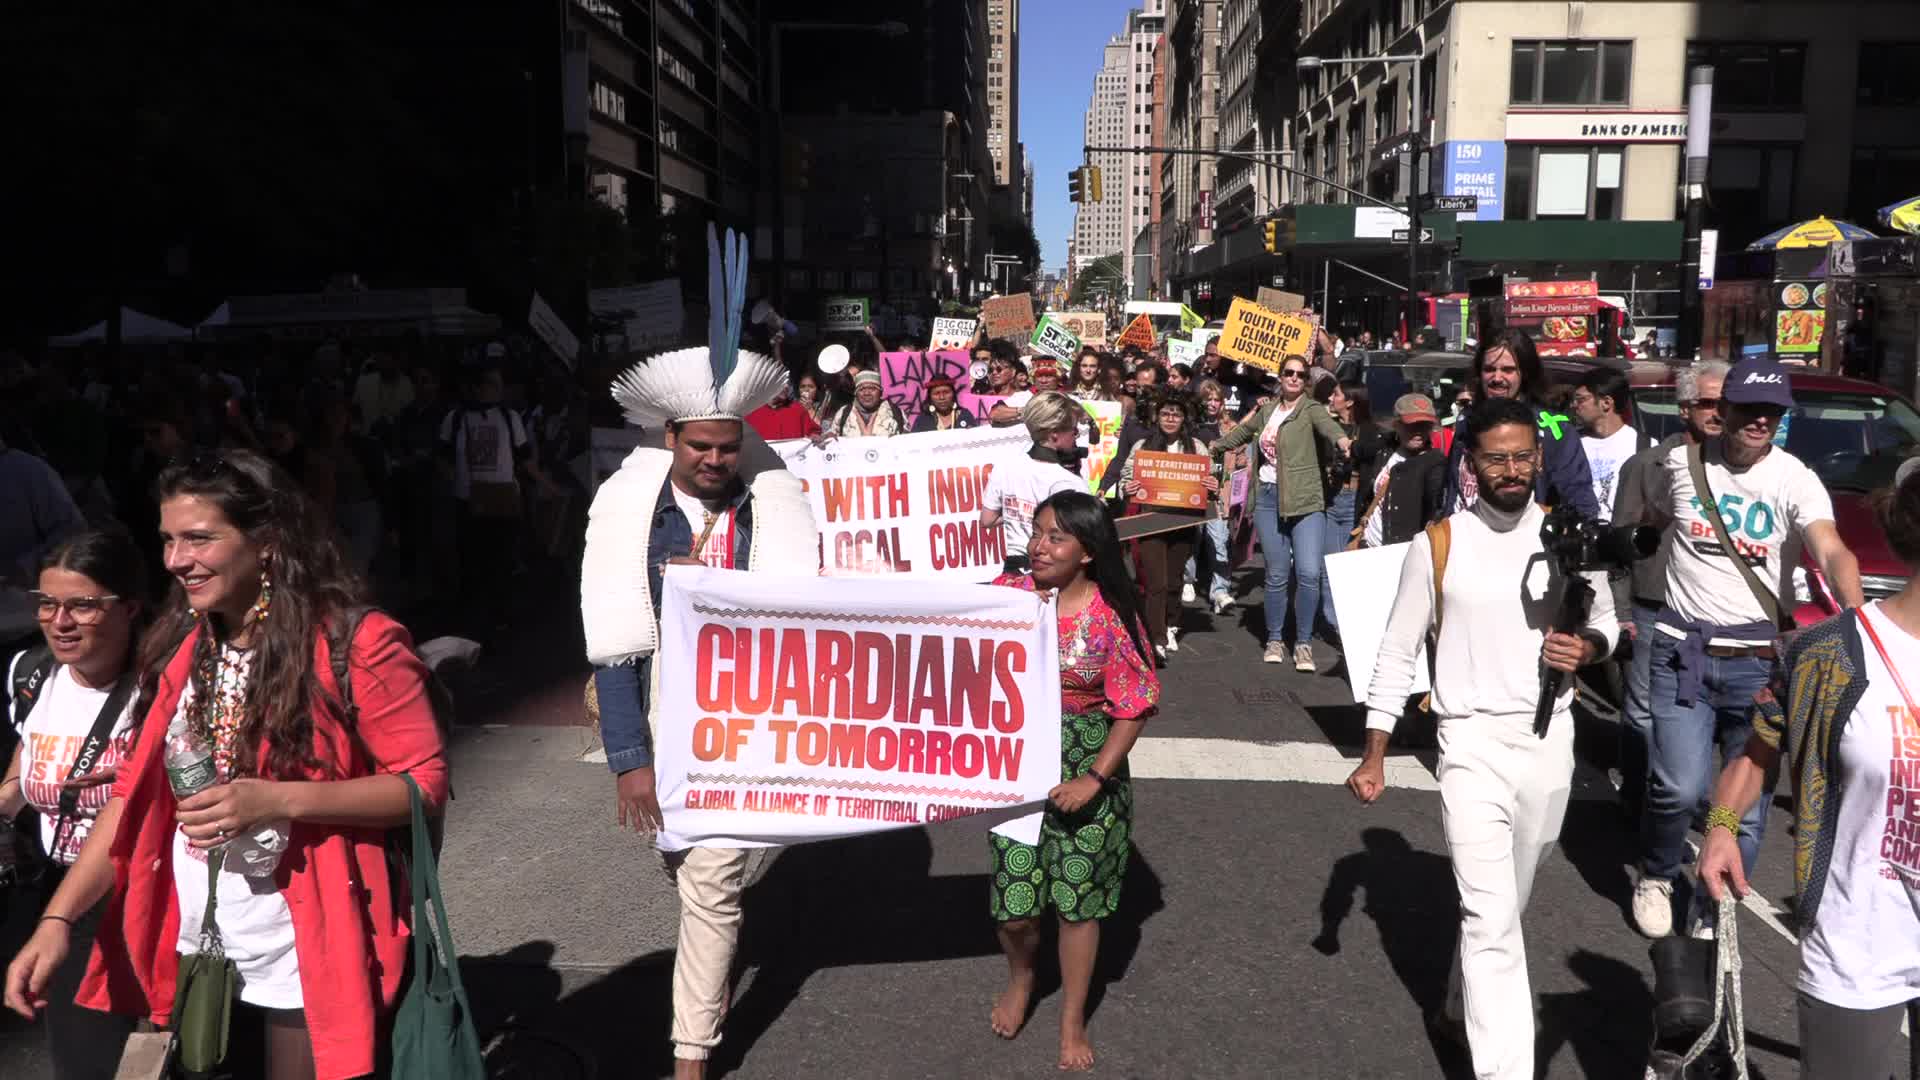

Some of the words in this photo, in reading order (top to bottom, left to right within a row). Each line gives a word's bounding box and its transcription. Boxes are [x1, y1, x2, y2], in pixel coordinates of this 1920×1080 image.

[1582, 124, 1617, 136] BANK
[1621, 124, 1637, 136] OF
[1456, 143, 1482, 159] 150
[1454, 172, 1496, 185] PRIME
[1454, 186, 1497, 198] RETAIL
[1440, 199, 1468, 210] Liberty
[936, 318, 955, 329] BIG
[957, 320, 974, 331] OIL
[1238, 309, 1276, 333] YOUTH
[1277, 322, 1302, 341] FOR
[1039, 336, 1071, 359] ECOCIDE
[1240, 325, 1290, 352] CLIMATE
[884, 351, 967, 388] LAND
[1138, 458, 1153, 467] OUR
[1155, 460, 1206, 472] TERRITORIES
[1141, 470, 1156, 478] OUR
[1158, 473, 1201, 481] DECISIONS
[821, 472, 910, 523] WITH
[696, 622, 1027, 734] GUARDIANS
[73, 736, 100, 779] SONY
[692, 717, 755, 763] OF
[768, 719, 1025, 782] TOMORROW
[685, 788, 737, 811] GLOBAL
[743, 791, 810, 816] ALLIANCE
[813, 794, 831, 817] OF
[835, 795, 921, 824] TERRITORIAL
